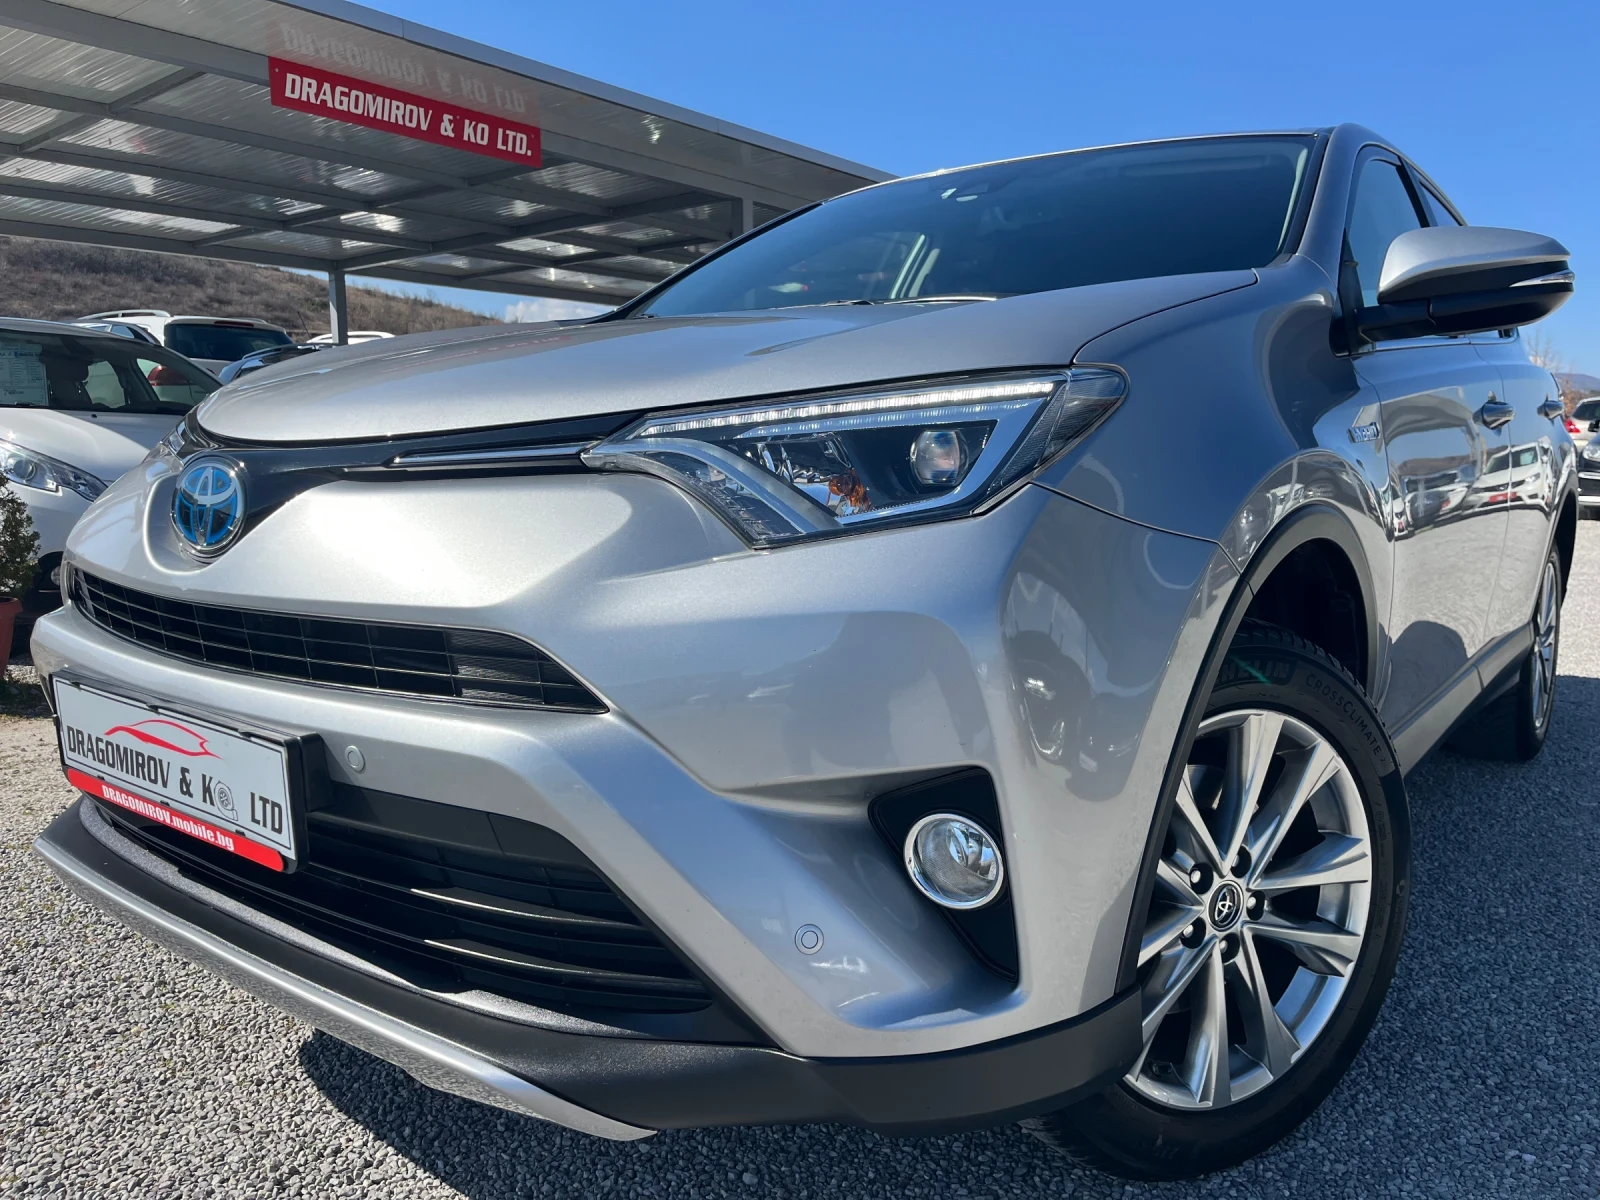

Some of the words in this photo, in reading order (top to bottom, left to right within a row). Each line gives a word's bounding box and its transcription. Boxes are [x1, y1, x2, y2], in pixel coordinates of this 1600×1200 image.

[284, 73, 432, 131] DRAGOMIROV
[440, 113, 455, 138] &
[463, 119, 489, 146] KO
[496, 127, 532, 156] LTD.
[1305, 673, 1382, 756] CROSSCLIMATE
[66, 725, 171, 789] DRAGOMIROV
[179, 766, 194, 799] &
[250, 792, 283, 835] LTD
[101, 784, 235, 851] DRAGOMIROV.mobile.bg
